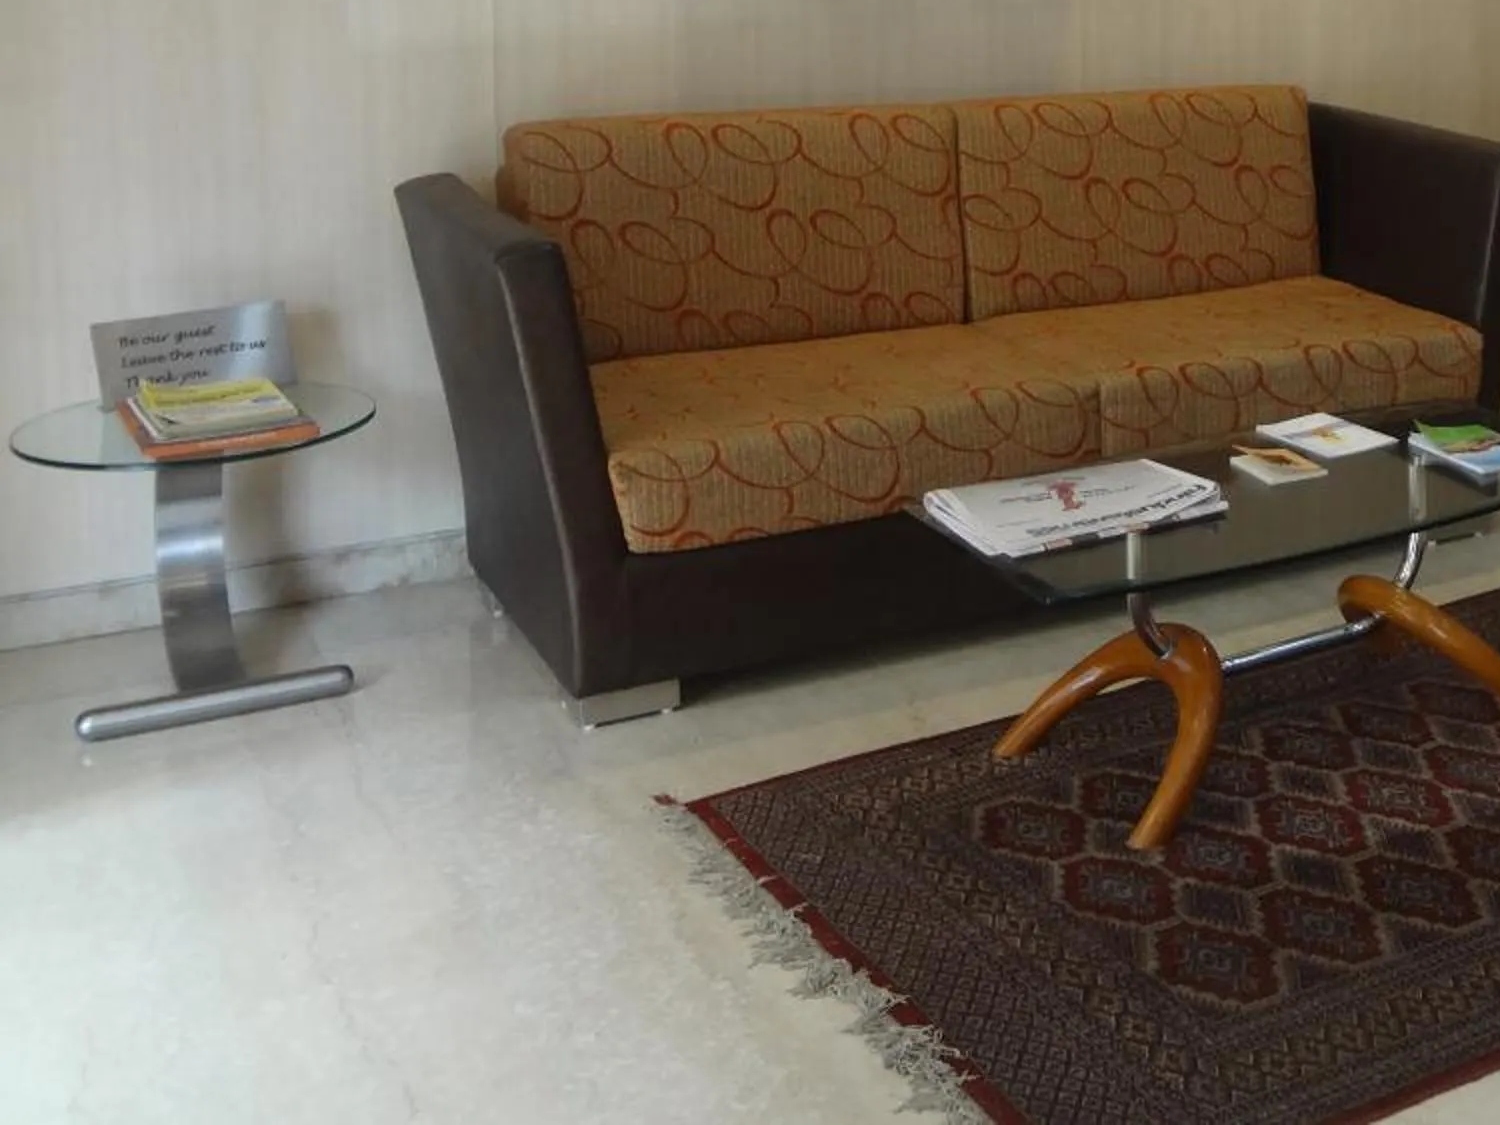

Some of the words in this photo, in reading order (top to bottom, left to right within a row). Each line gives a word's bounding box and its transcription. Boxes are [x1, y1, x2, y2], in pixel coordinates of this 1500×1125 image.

[142, 332, 169, 345] our
[174, 325, 216, 344] guest
[121, 353, 167, 368] Leave
[169, 348, 194, 362] the
[199, 342, 228, 357] rest
[229, 340, 245, 352] to
[249, 339, 267, 349] us
